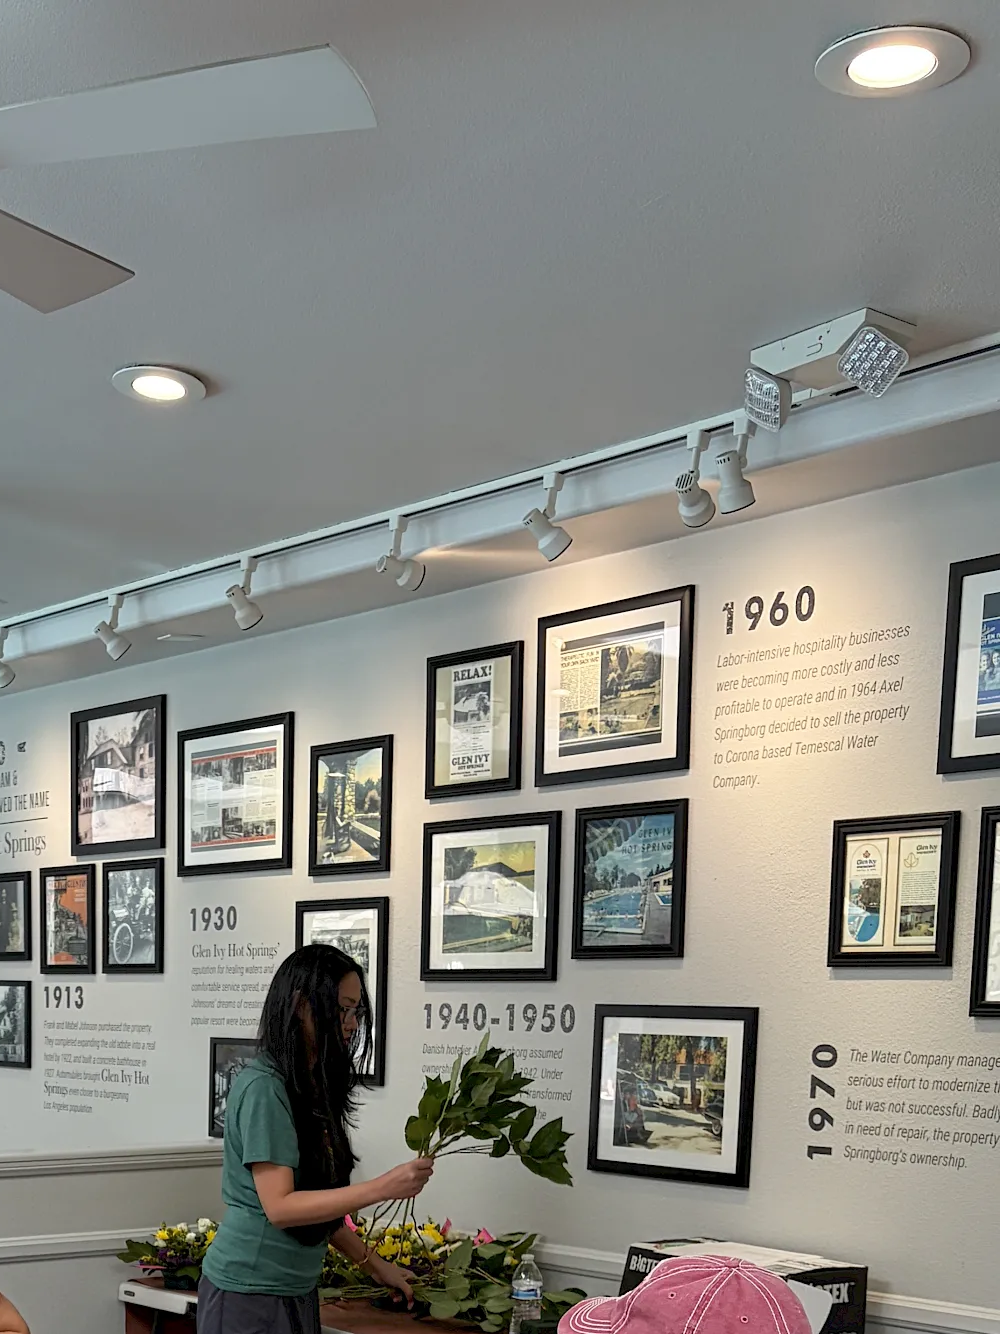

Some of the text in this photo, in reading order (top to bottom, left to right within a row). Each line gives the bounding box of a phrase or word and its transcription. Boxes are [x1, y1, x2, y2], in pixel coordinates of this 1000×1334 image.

[722, 585, 815, 634] 1960
[717, 624, 911, 668] Labor-intensive hospitality businesses
[453, 665, 492, 682] RELAX!
[716, 653, 900, 692] were becoming more costly and less
[714, 677, 904, 720] profitable to operate and in 1964 Axel
[714, 704, 910, 743] Springborg decided to sell the property
[714, 734, 879, 764] to Corona based Temescal Water
[452, 754, 490, 766] GLEN IVY
[713, 773, 760, 790] Company.
[14, 794, 27, 811] THE
[30, 791, 50, 808] NAME
[639, 828, 659, 838] GLEN
[4, 830, 46, 858] Springs
[622, 841, 672, 854] HOT SPRING
[190, 906, 237, 931] 1930
[192, 942, 280, 960] Glen Ivy Hot Springs'
[226, 964, 244, 976] healing
[245, 965, 263, 974] waters
[264, 964, 275, 974] and
[191, 982, 221, 991] comfortable
[222, 983, 240, 991] service
[44, 986, 84, 1009] 1913
[217, 999, 235, 1009] dreams
[237, 999, 243, 1008] of
[44, 1020, 55, 1030] Frank
[56, 1021, 64, 1030] and
[65, 1021, 79, 1030] Mabel
[79, 1022, 97, 1031] Johnson
[98, 1022, 122, 1032] purchased
[191, 1017, 238, 1027] popular resort were
[423, 1003, 576, 1033] 1940-1950
[44, 1036, 54, 1047] They
[55, 1038, 77, 1048] completed
[78, 1038, 100, 1050] expanding
[100, 1039, 108, 1048] the
[109, 1039, 117, 1049] old
[132, 1041, 141, 1050] into
[147, 1041, 156, 1051] real
[422, 1044, 445, 1055] Danish
[529, 1049, 563, 1059] assumed
[44, 1053, 54, 1062] hotel
[96, 1057, 116, 1065] concrete
[850, 1049, 868, 1062] The
[871, 1050, 901, 1064] Water
[904, 1051, 954, 1069] Company
[101, 1068, 119, 1083] Glen
[121, 1070, 133, 1086] Ivy
[134, 1071, 150, 1085] Hot
[541, 1069, 563, 1080] Under
[847, 1074, 884, 1088] serious
[887, 1076, 916, 1089] effort
[918, 1078, 929, 1090] to
[931, 1079, 990, 1093] modernize
[44, 1081, 68, 1097] Springs
[69, 1088, 79, 1096] even
[52, 1101, 69, 1112] Angeles
[69, 1103, 92, 1113] population
[807, 1044, 838, 1160] 1970
[846, 1098, 863, 1111] but
[865, 1102, 885, 1113] was
[888, 1101, 905, 1114] not
[908, 1103, 968, 1117] successful.
[844, 1121, 1000, 1148] in need of repair, the property
[844, 1145, 967, 1170] Springborg's ownership.
